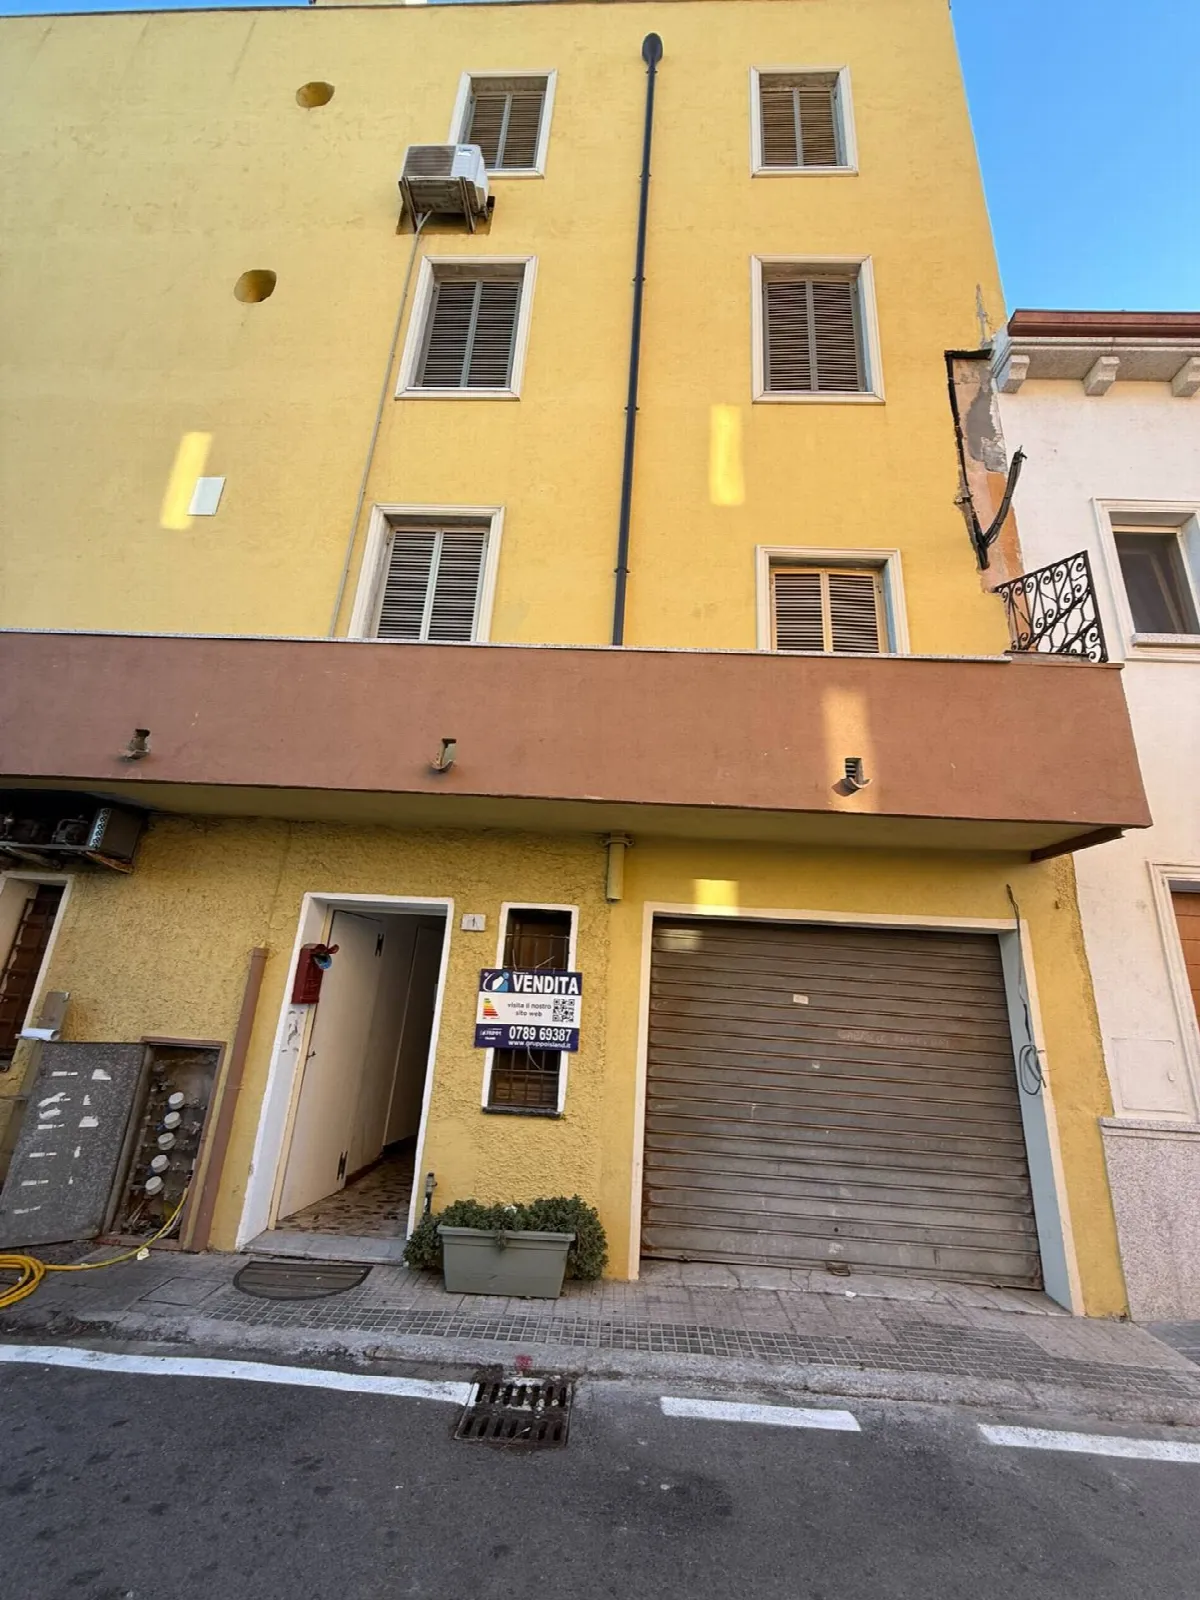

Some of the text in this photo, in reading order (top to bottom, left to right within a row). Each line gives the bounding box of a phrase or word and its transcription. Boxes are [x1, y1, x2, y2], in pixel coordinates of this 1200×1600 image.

[512, 974, 579, 995] VENDITA
[508, 1026, 536, 1040] 0789
[539, 1027, 572, 1042] 69387
[508, 1040, 571, 1049] www.gruppoisland.it
